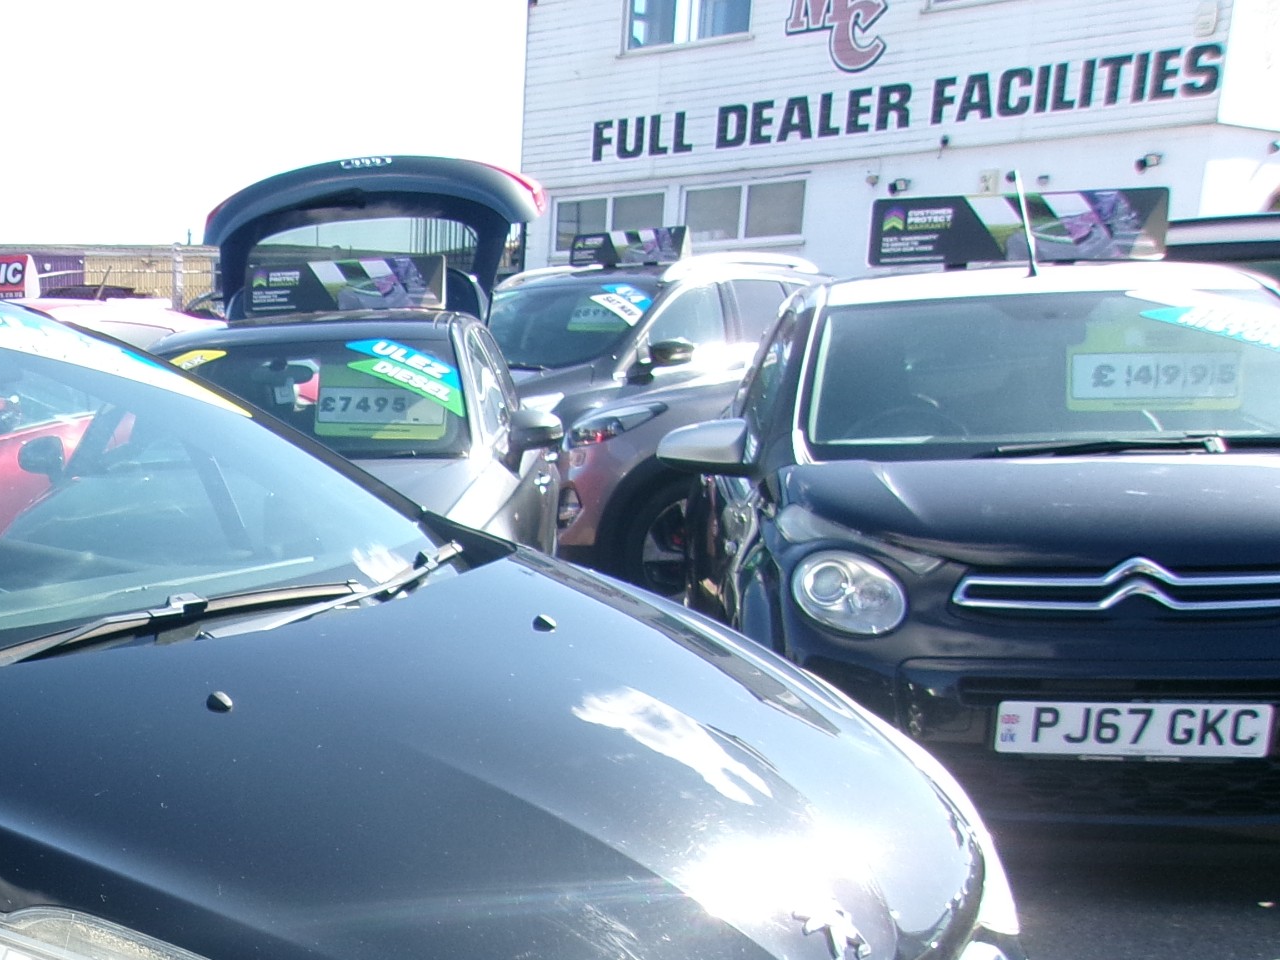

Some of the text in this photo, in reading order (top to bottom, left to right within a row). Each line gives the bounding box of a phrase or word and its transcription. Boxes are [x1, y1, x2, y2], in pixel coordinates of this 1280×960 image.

[592, 43, 1224, 162] FULL DEALER FACILITIES
[372, 341, 451, 379] ULEZ
[372, 361, 452, 402] DIESEL
[320, 396, 406, 413] £7495
[1000, 733, 1016, 743] UK
[1031, 706, 1260, 746] PJ67 GKC
